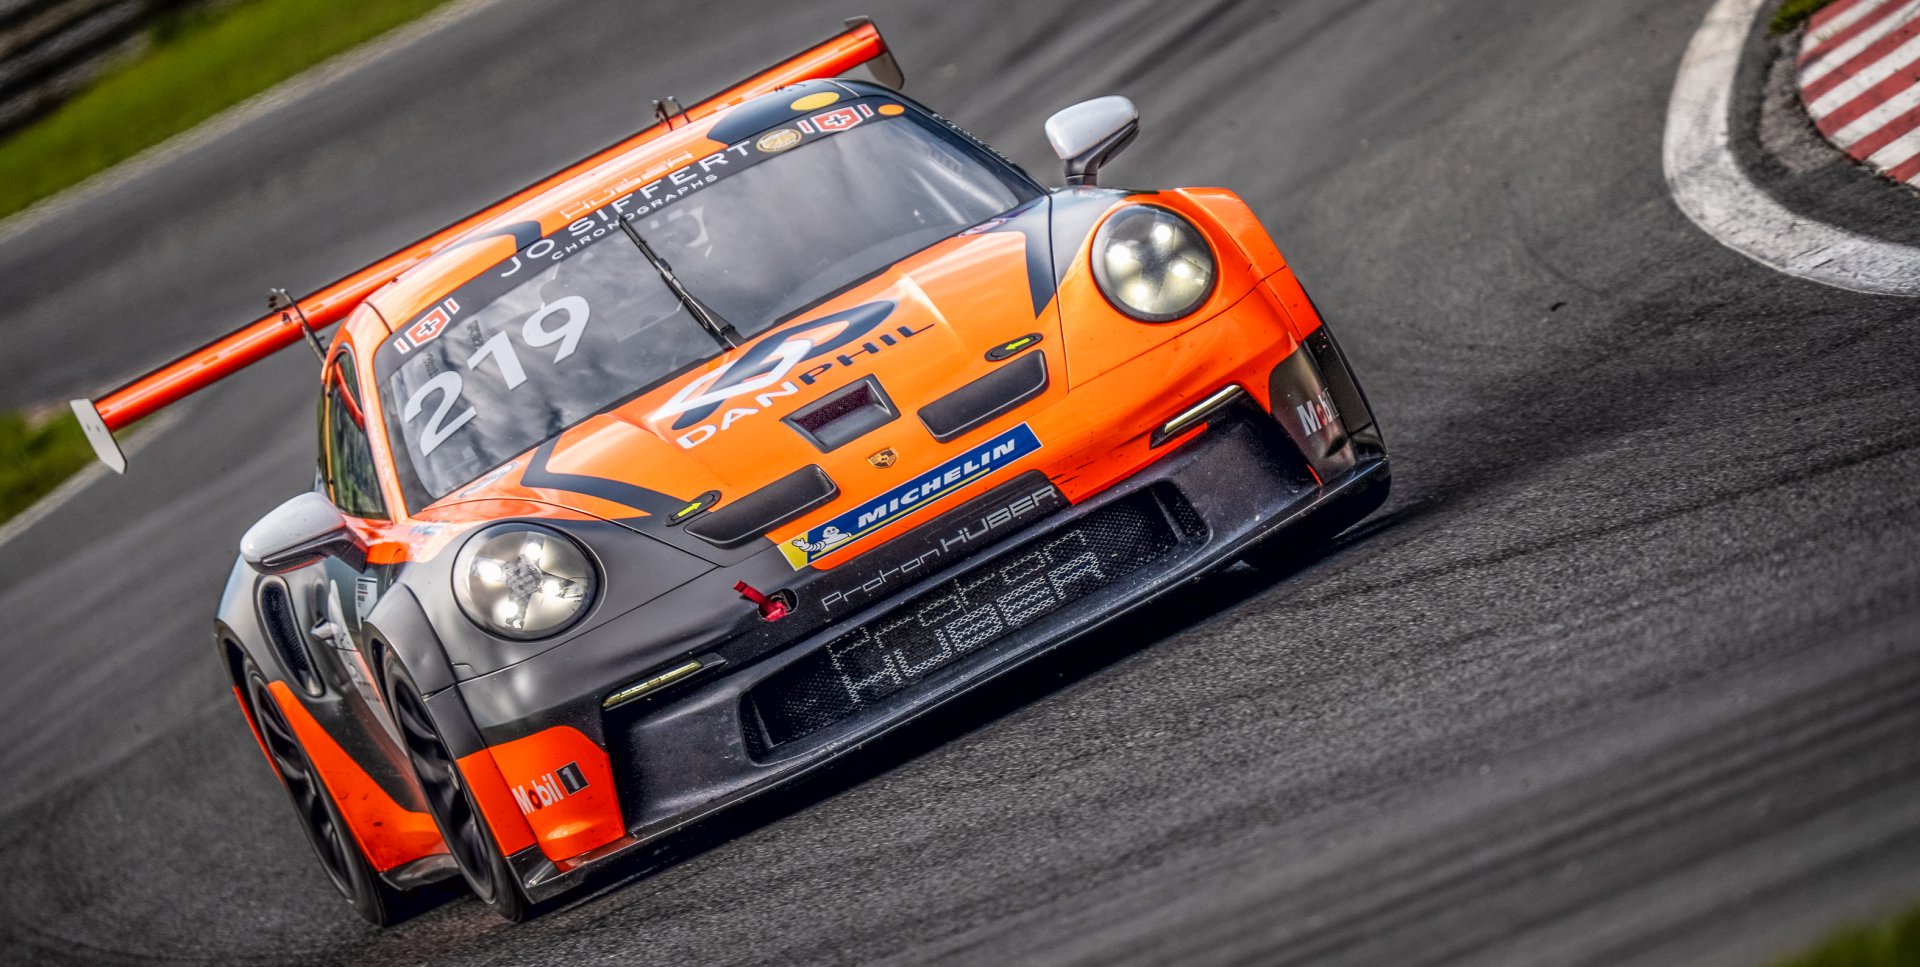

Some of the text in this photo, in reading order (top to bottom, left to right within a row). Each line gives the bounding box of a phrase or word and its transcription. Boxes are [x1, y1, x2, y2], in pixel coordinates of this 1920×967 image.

[500, 140, 750, 277] JO SIFFERT
[404, 295, 590, 457] 219
[675, 322, 936, 449] DANPHIL
[857, 438, 1015, 529] MICHELIN
[821, 484, 1058, 612] Proton HUBER
[842, 552, 1106, 703] HUBER
[511, 772, 565, 816] Mobil
